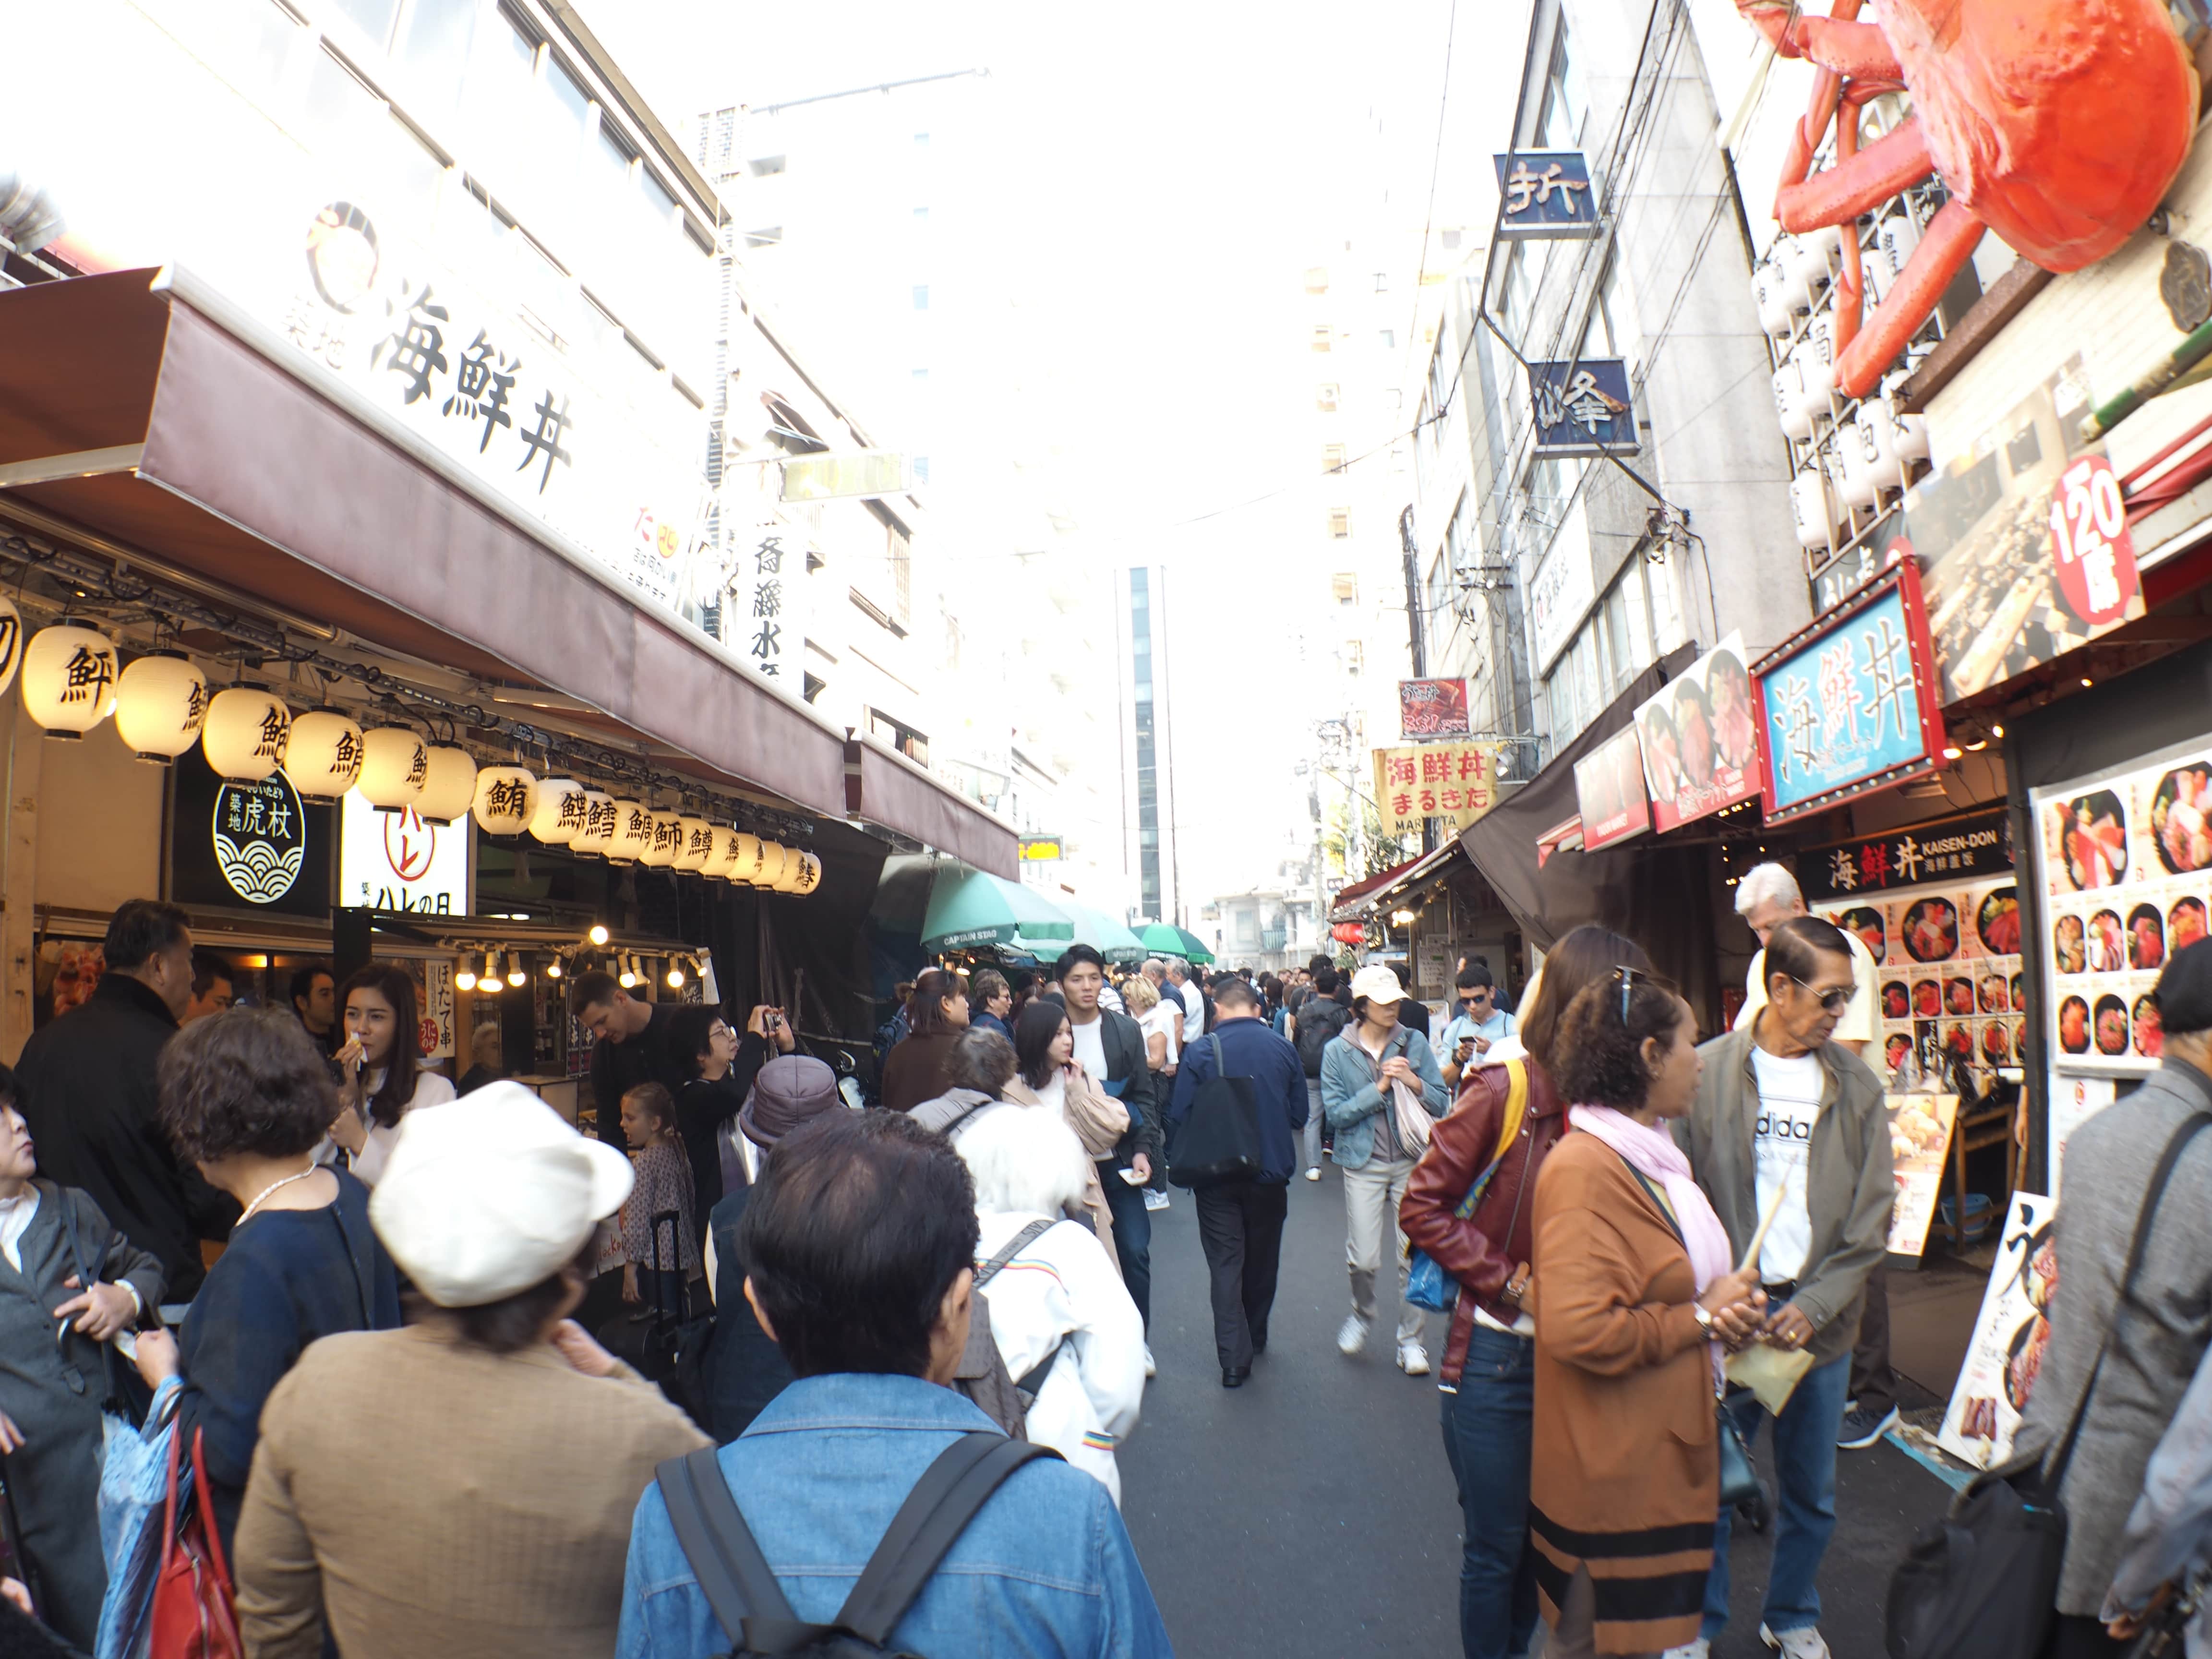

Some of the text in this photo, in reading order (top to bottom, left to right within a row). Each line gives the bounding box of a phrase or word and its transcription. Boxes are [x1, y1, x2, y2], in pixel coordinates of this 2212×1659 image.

[369, 276, 575, 496] 海鮮丼
[2050, 469, 2123, 564] 120
[1773, 618, 1914, 783] 海鮮丼
[1387, 750, 1486, 786] 海鮮丼
[228, 792, 241, 832] 築地
[242, 795, 292, 839] 虎杖
[488, 778, 527, 818] 鮪
[1392, 788, 1487, 815] まるきた
[586, 801, 617, 840] 鱈
[626, 809, 653, 846] 鯛
[1828, 836, 1924, 890] 海鮮丼
[1922, 830, 1998, 856] KAISEN-DON
[376, 887, 450, 914] ハレの日
[944, 929, 997, 946] CAPTAIN STAG
[437, 964, 451, 1049] ほたて串
